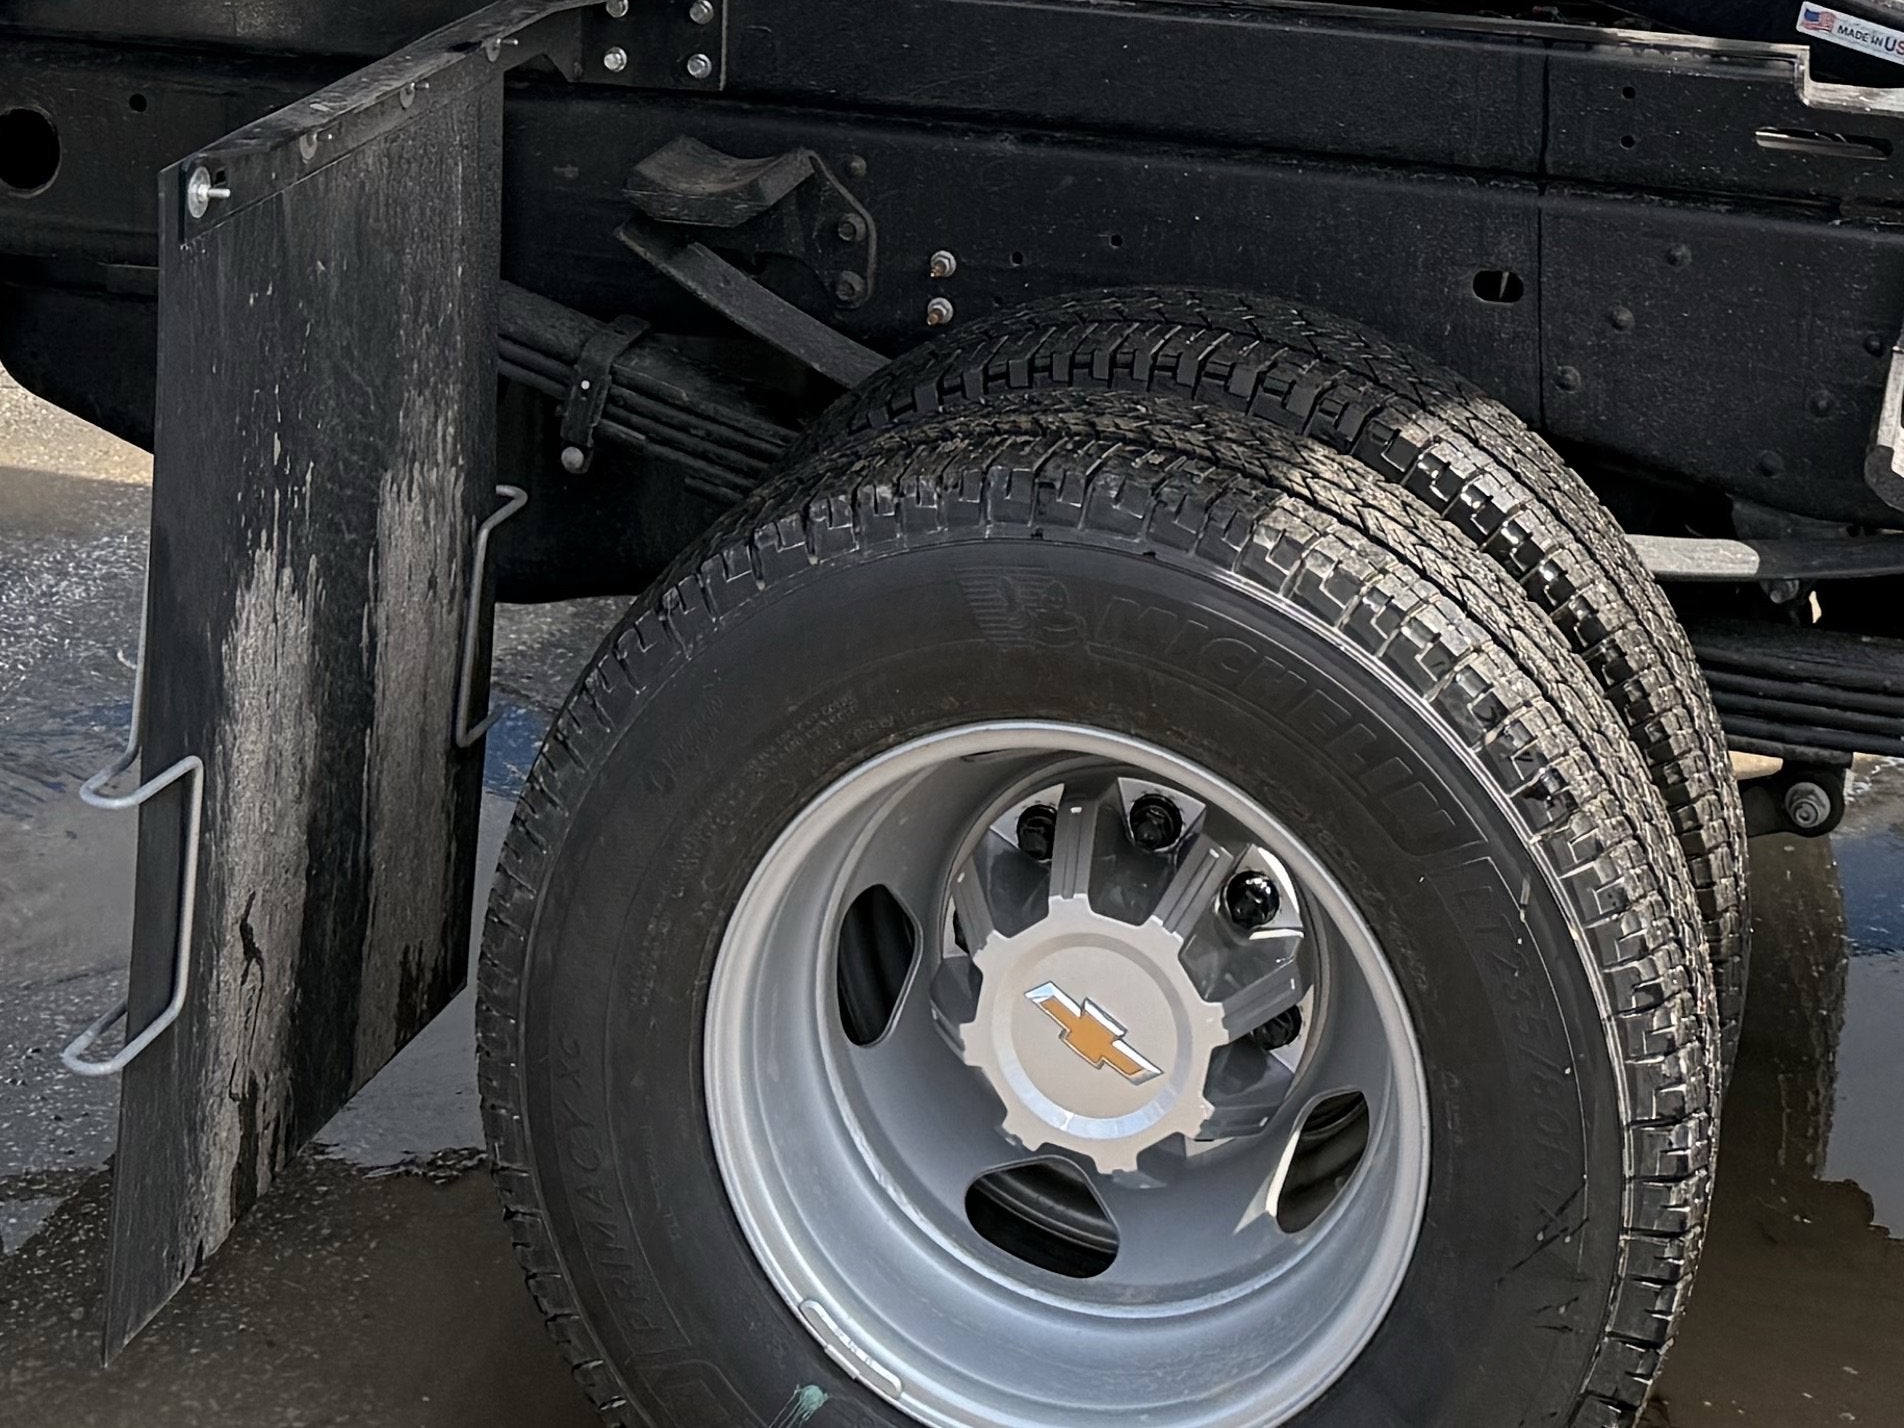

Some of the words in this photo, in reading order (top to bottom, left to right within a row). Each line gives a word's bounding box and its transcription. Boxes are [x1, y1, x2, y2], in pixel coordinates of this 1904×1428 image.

[1836, 23, 1870, 42] MADE
[1094, 596, 1456, 844] MICHELIN
[561, 1100, 666, 1332] PRIMACY
